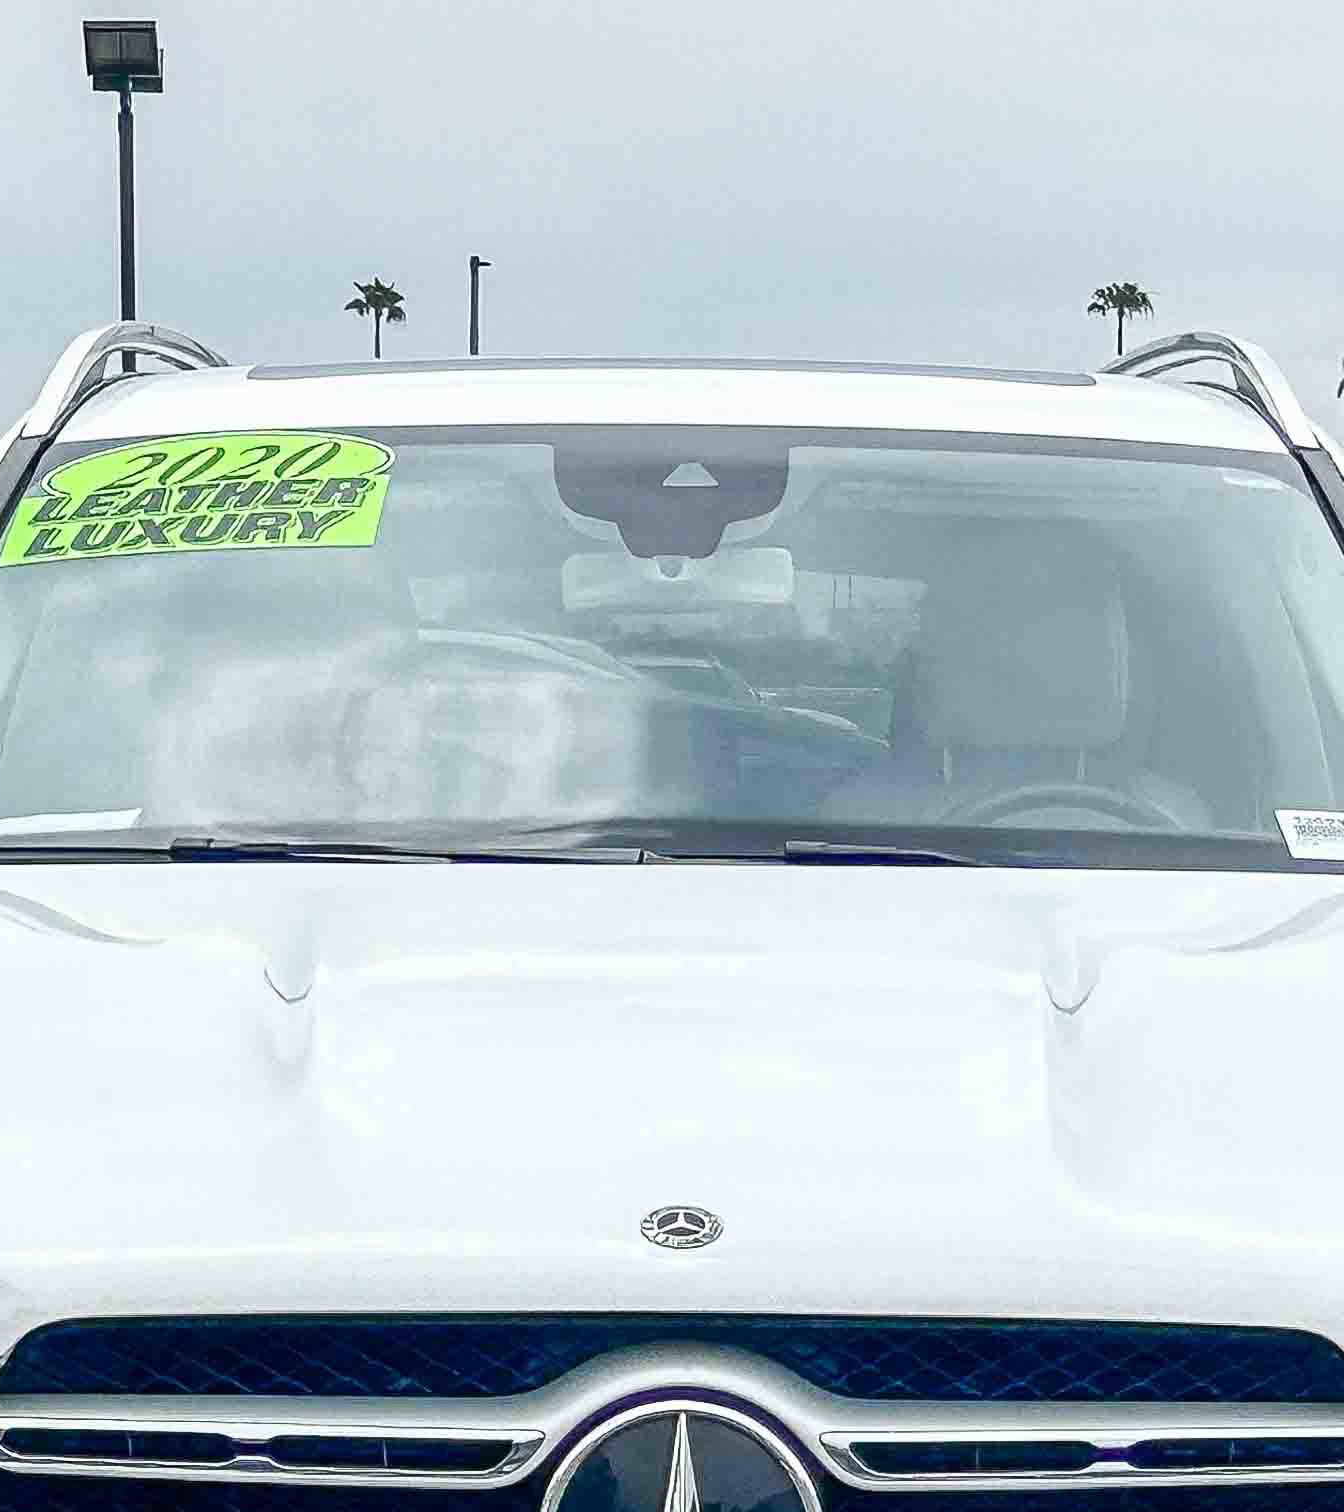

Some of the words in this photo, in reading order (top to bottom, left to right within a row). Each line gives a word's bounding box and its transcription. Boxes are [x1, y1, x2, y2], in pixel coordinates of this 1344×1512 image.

[96, 441, 342, 491] 2020
[29, 475, 376, 525] LEATHER
[23, 509, 354, 558] LUXURY
